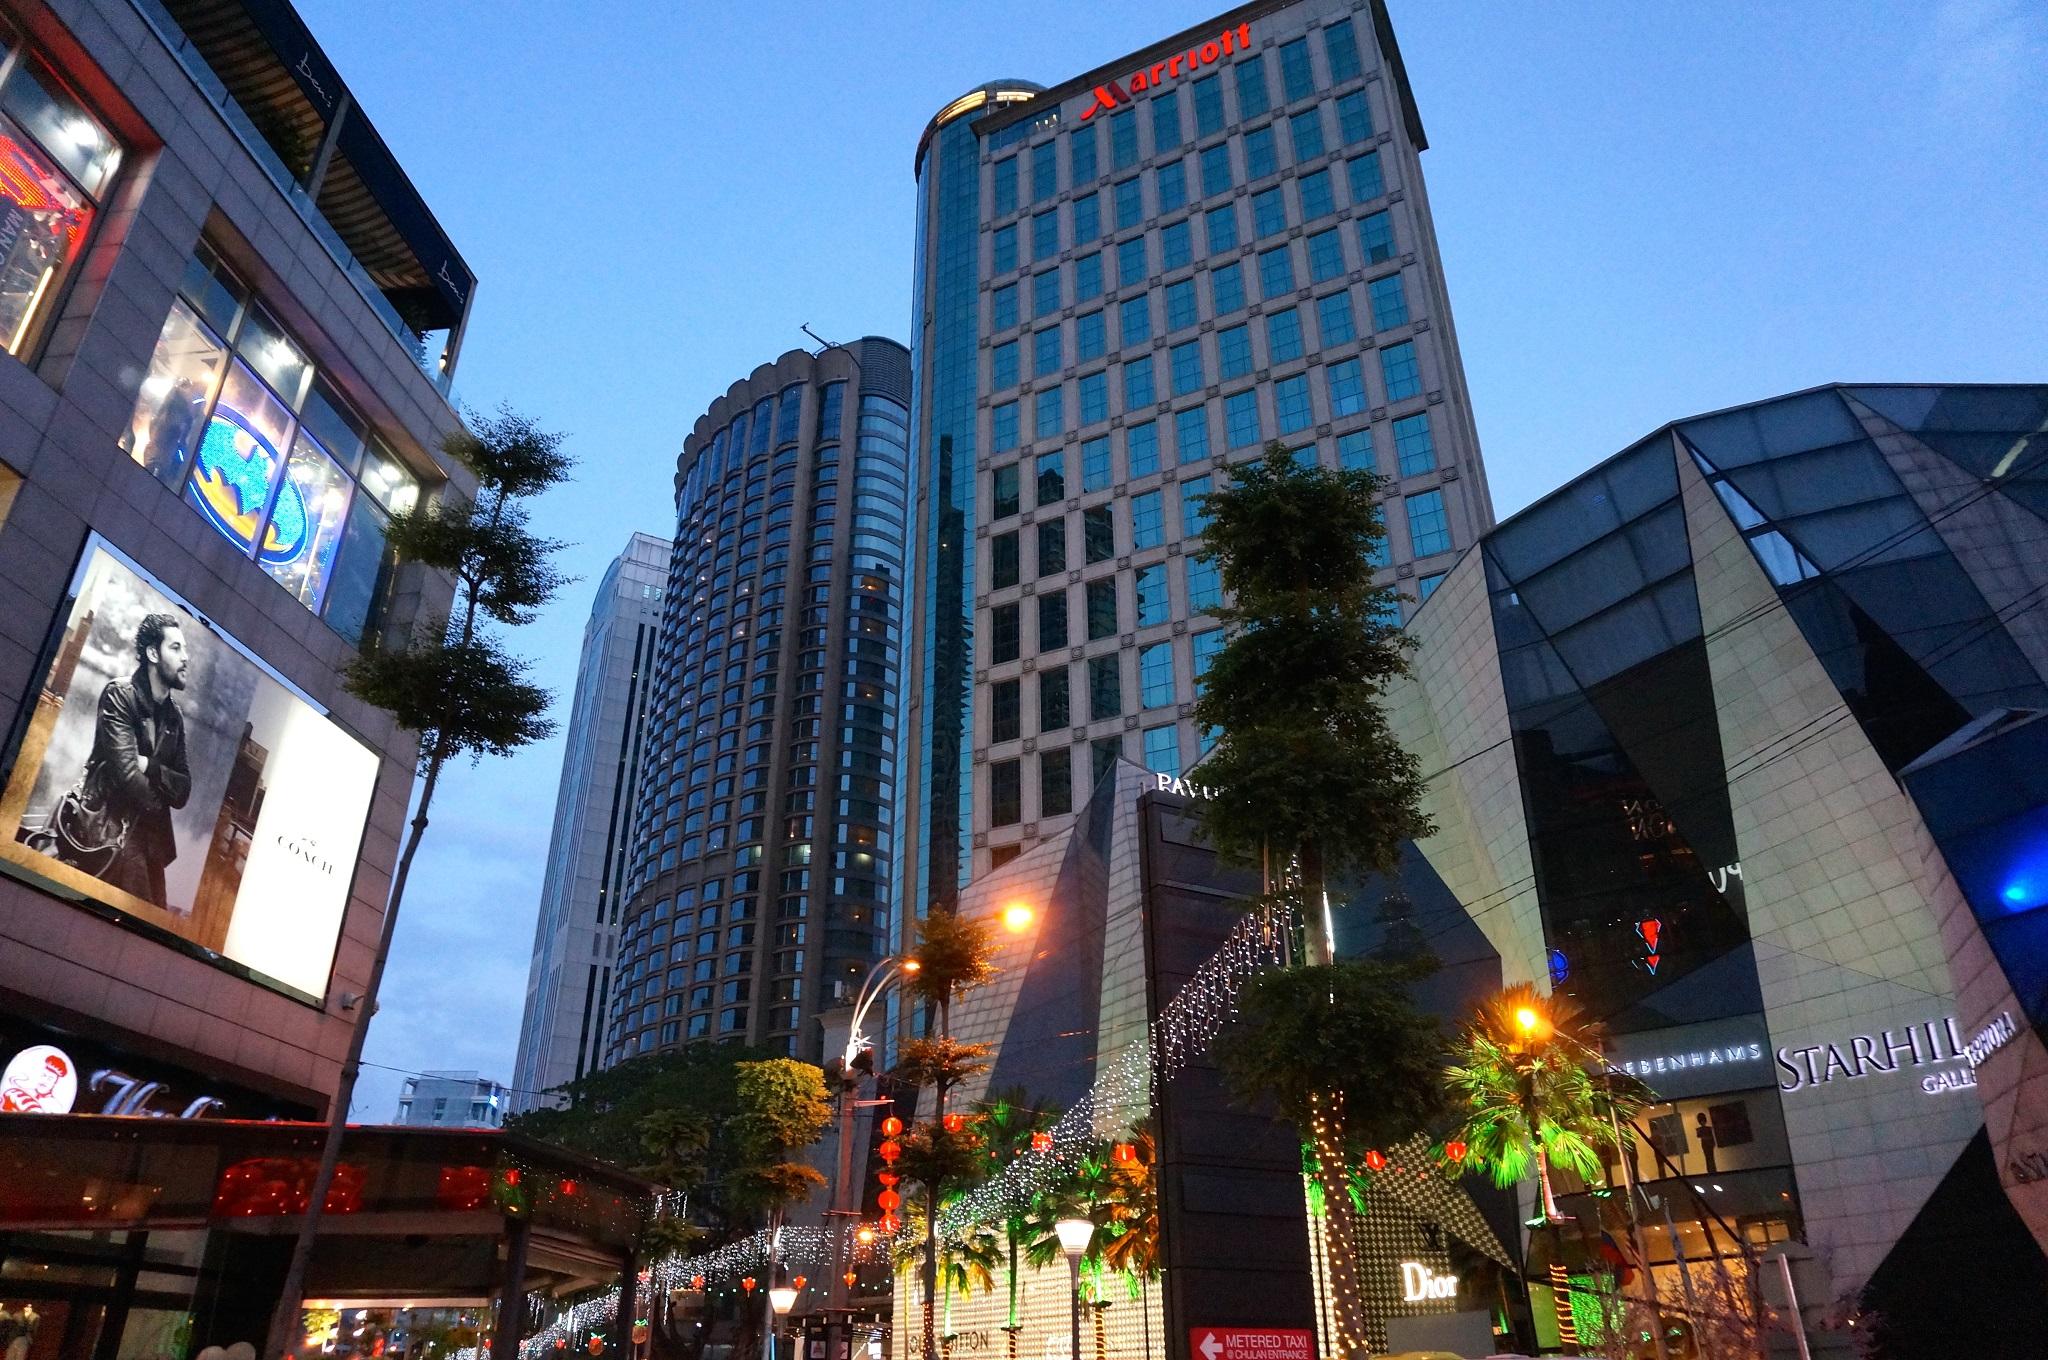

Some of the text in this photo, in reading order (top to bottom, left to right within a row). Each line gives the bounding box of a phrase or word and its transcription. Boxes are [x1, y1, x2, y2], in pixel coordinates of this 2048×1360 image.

[1080, 22, 1250, 121] Marriott
[277, 836, 333, 874] COACH
[1400, 1262, 1458, 1301] Dior
[1225, 1335, 1308, 1348] METERED TAXI
[1235, 1350, 1267, 1360] CHULAN
[1268, 1350, 1308, 1360] ENTRANCE
